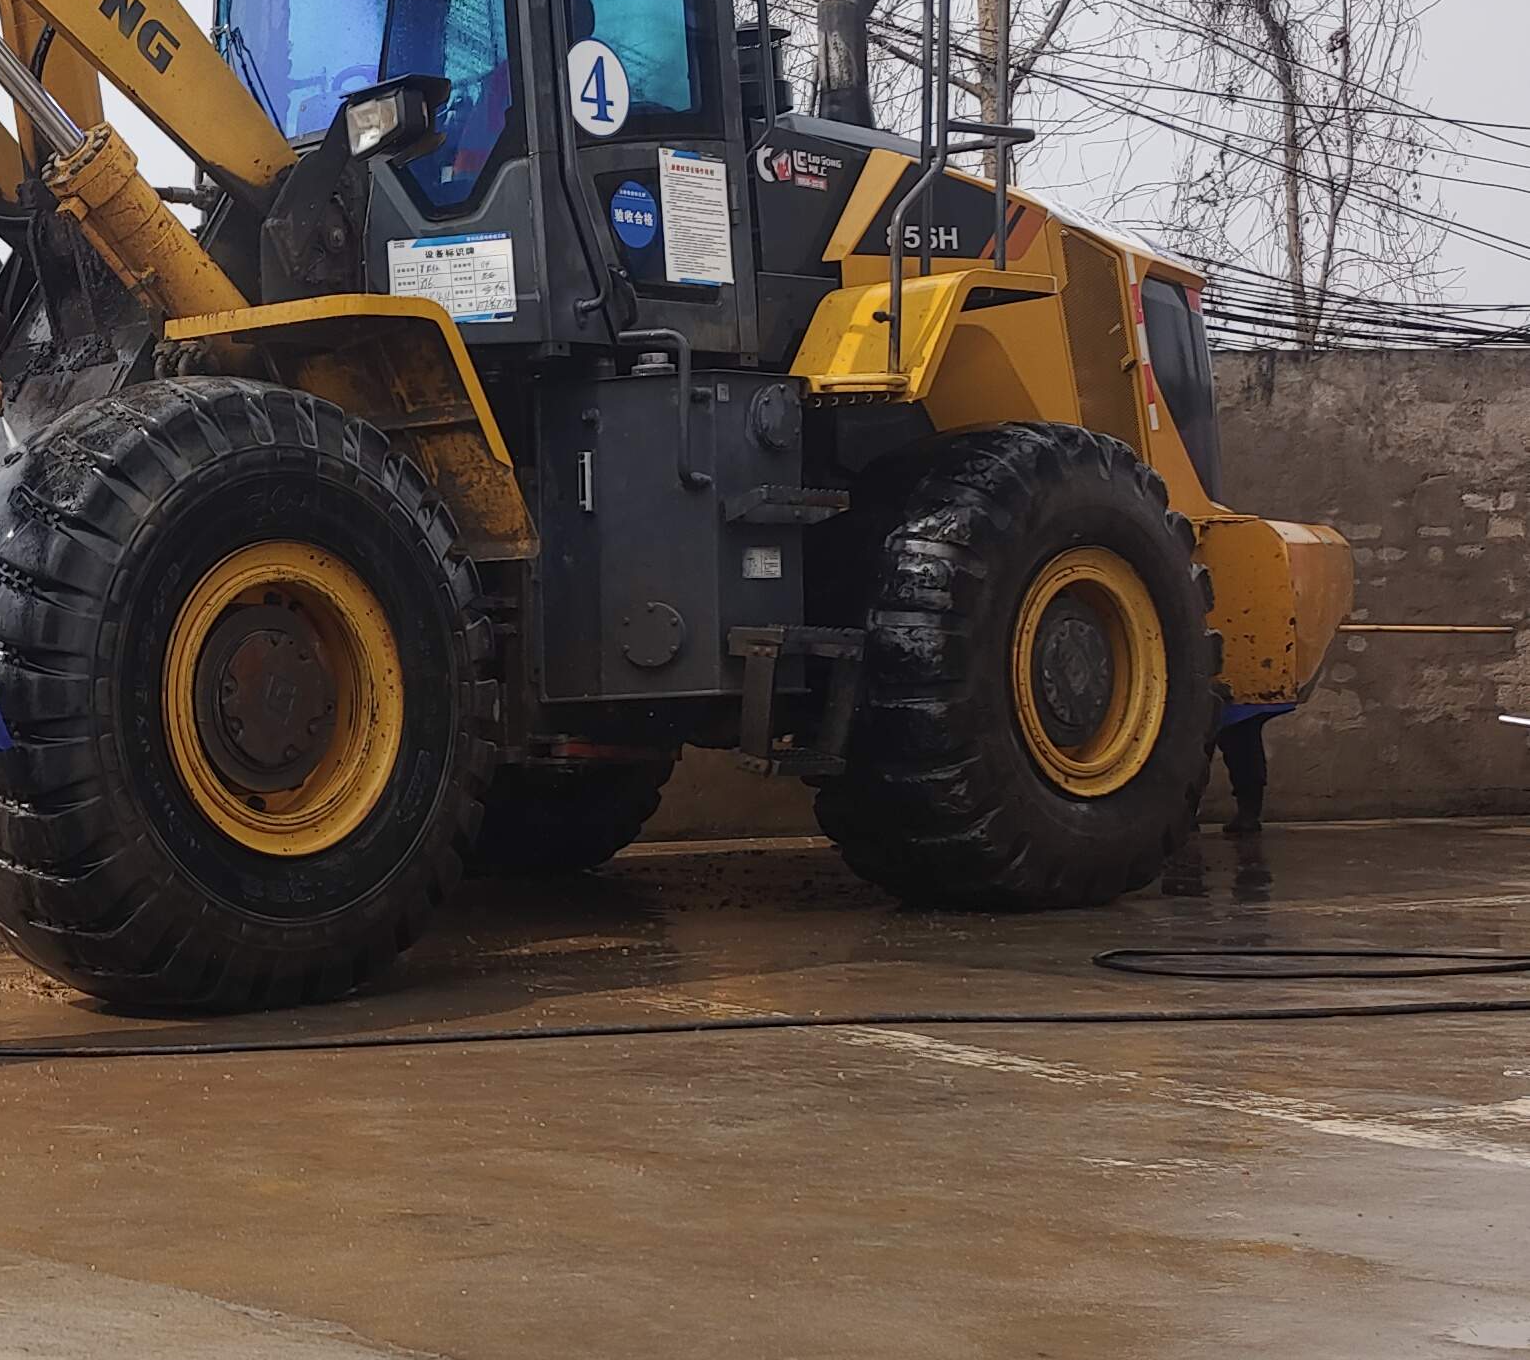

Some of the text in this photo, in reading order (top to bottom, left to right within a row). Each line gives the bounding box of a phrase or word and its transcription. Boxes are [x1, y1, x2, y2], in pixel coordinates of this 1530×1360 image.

[580, 55, 614, 123] 4
[614, 208, 654, 227] 验收合格
